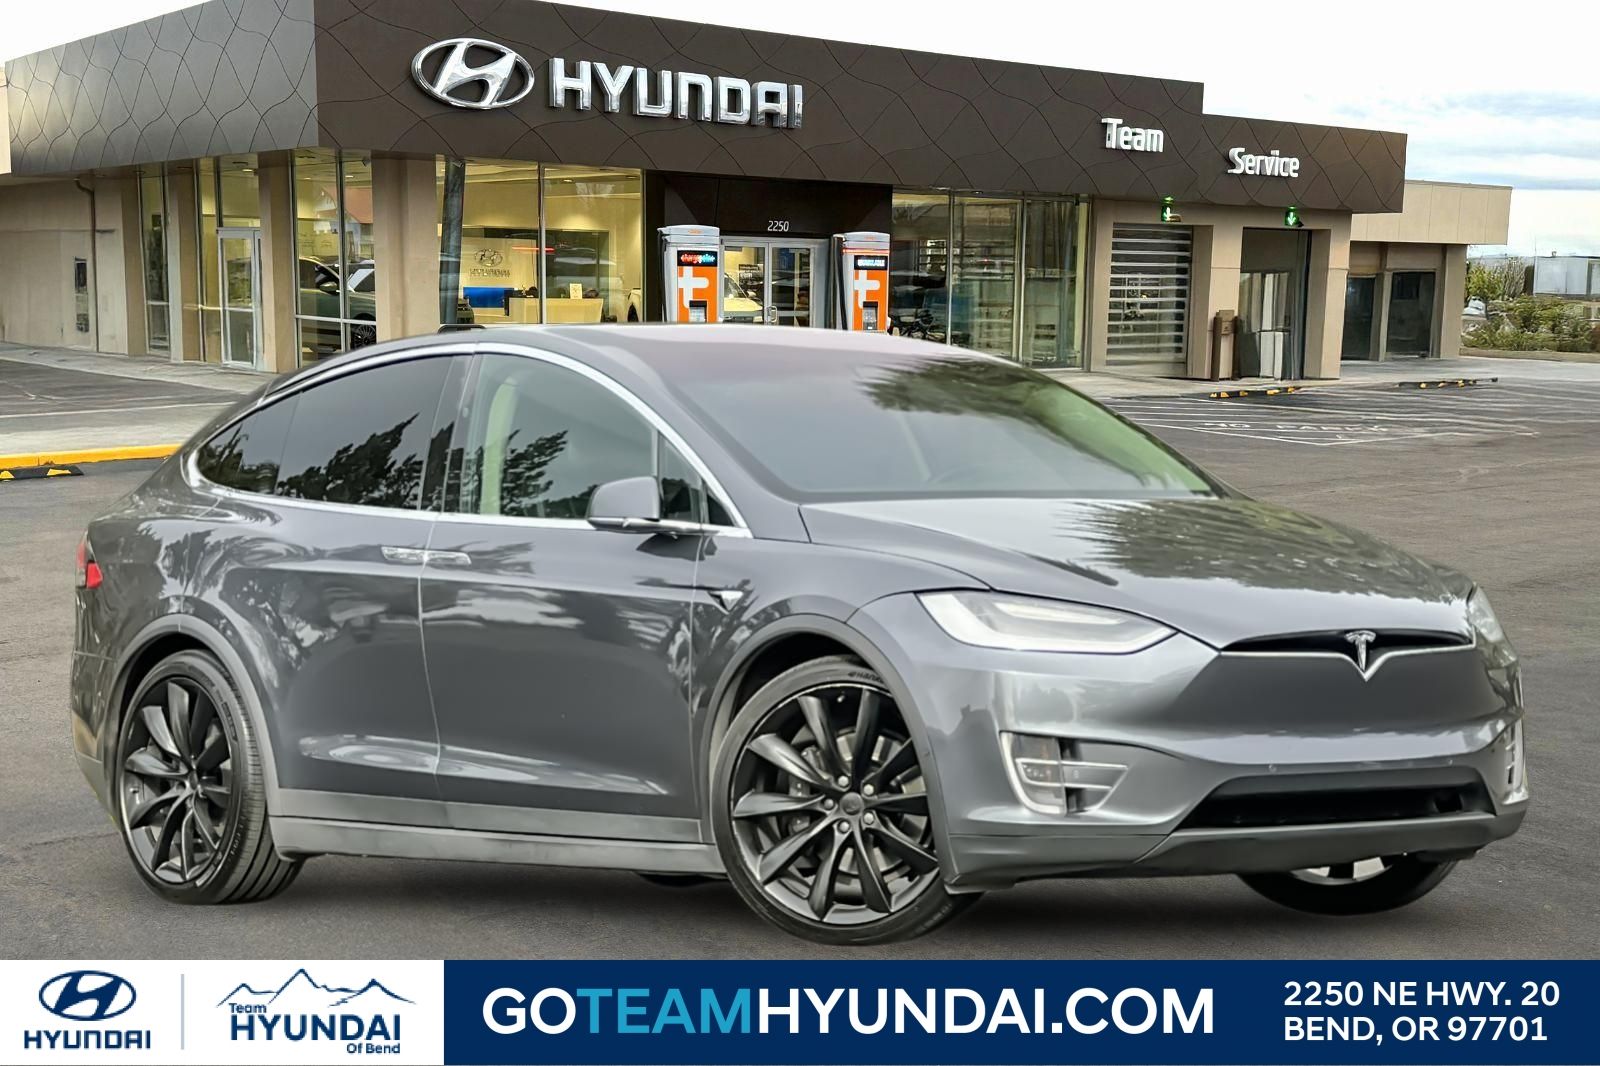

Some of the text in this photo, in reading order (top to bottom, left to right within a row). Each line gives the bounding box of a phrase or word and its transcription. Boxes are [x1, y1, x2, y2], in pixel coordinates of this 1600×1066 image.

[549, 57, 803, 129] HYUNDAI
[1101, 117, 1164, 152] Team
[1227, 147, 1300, 178] Service
[767, 220, 790, 232] 2250
